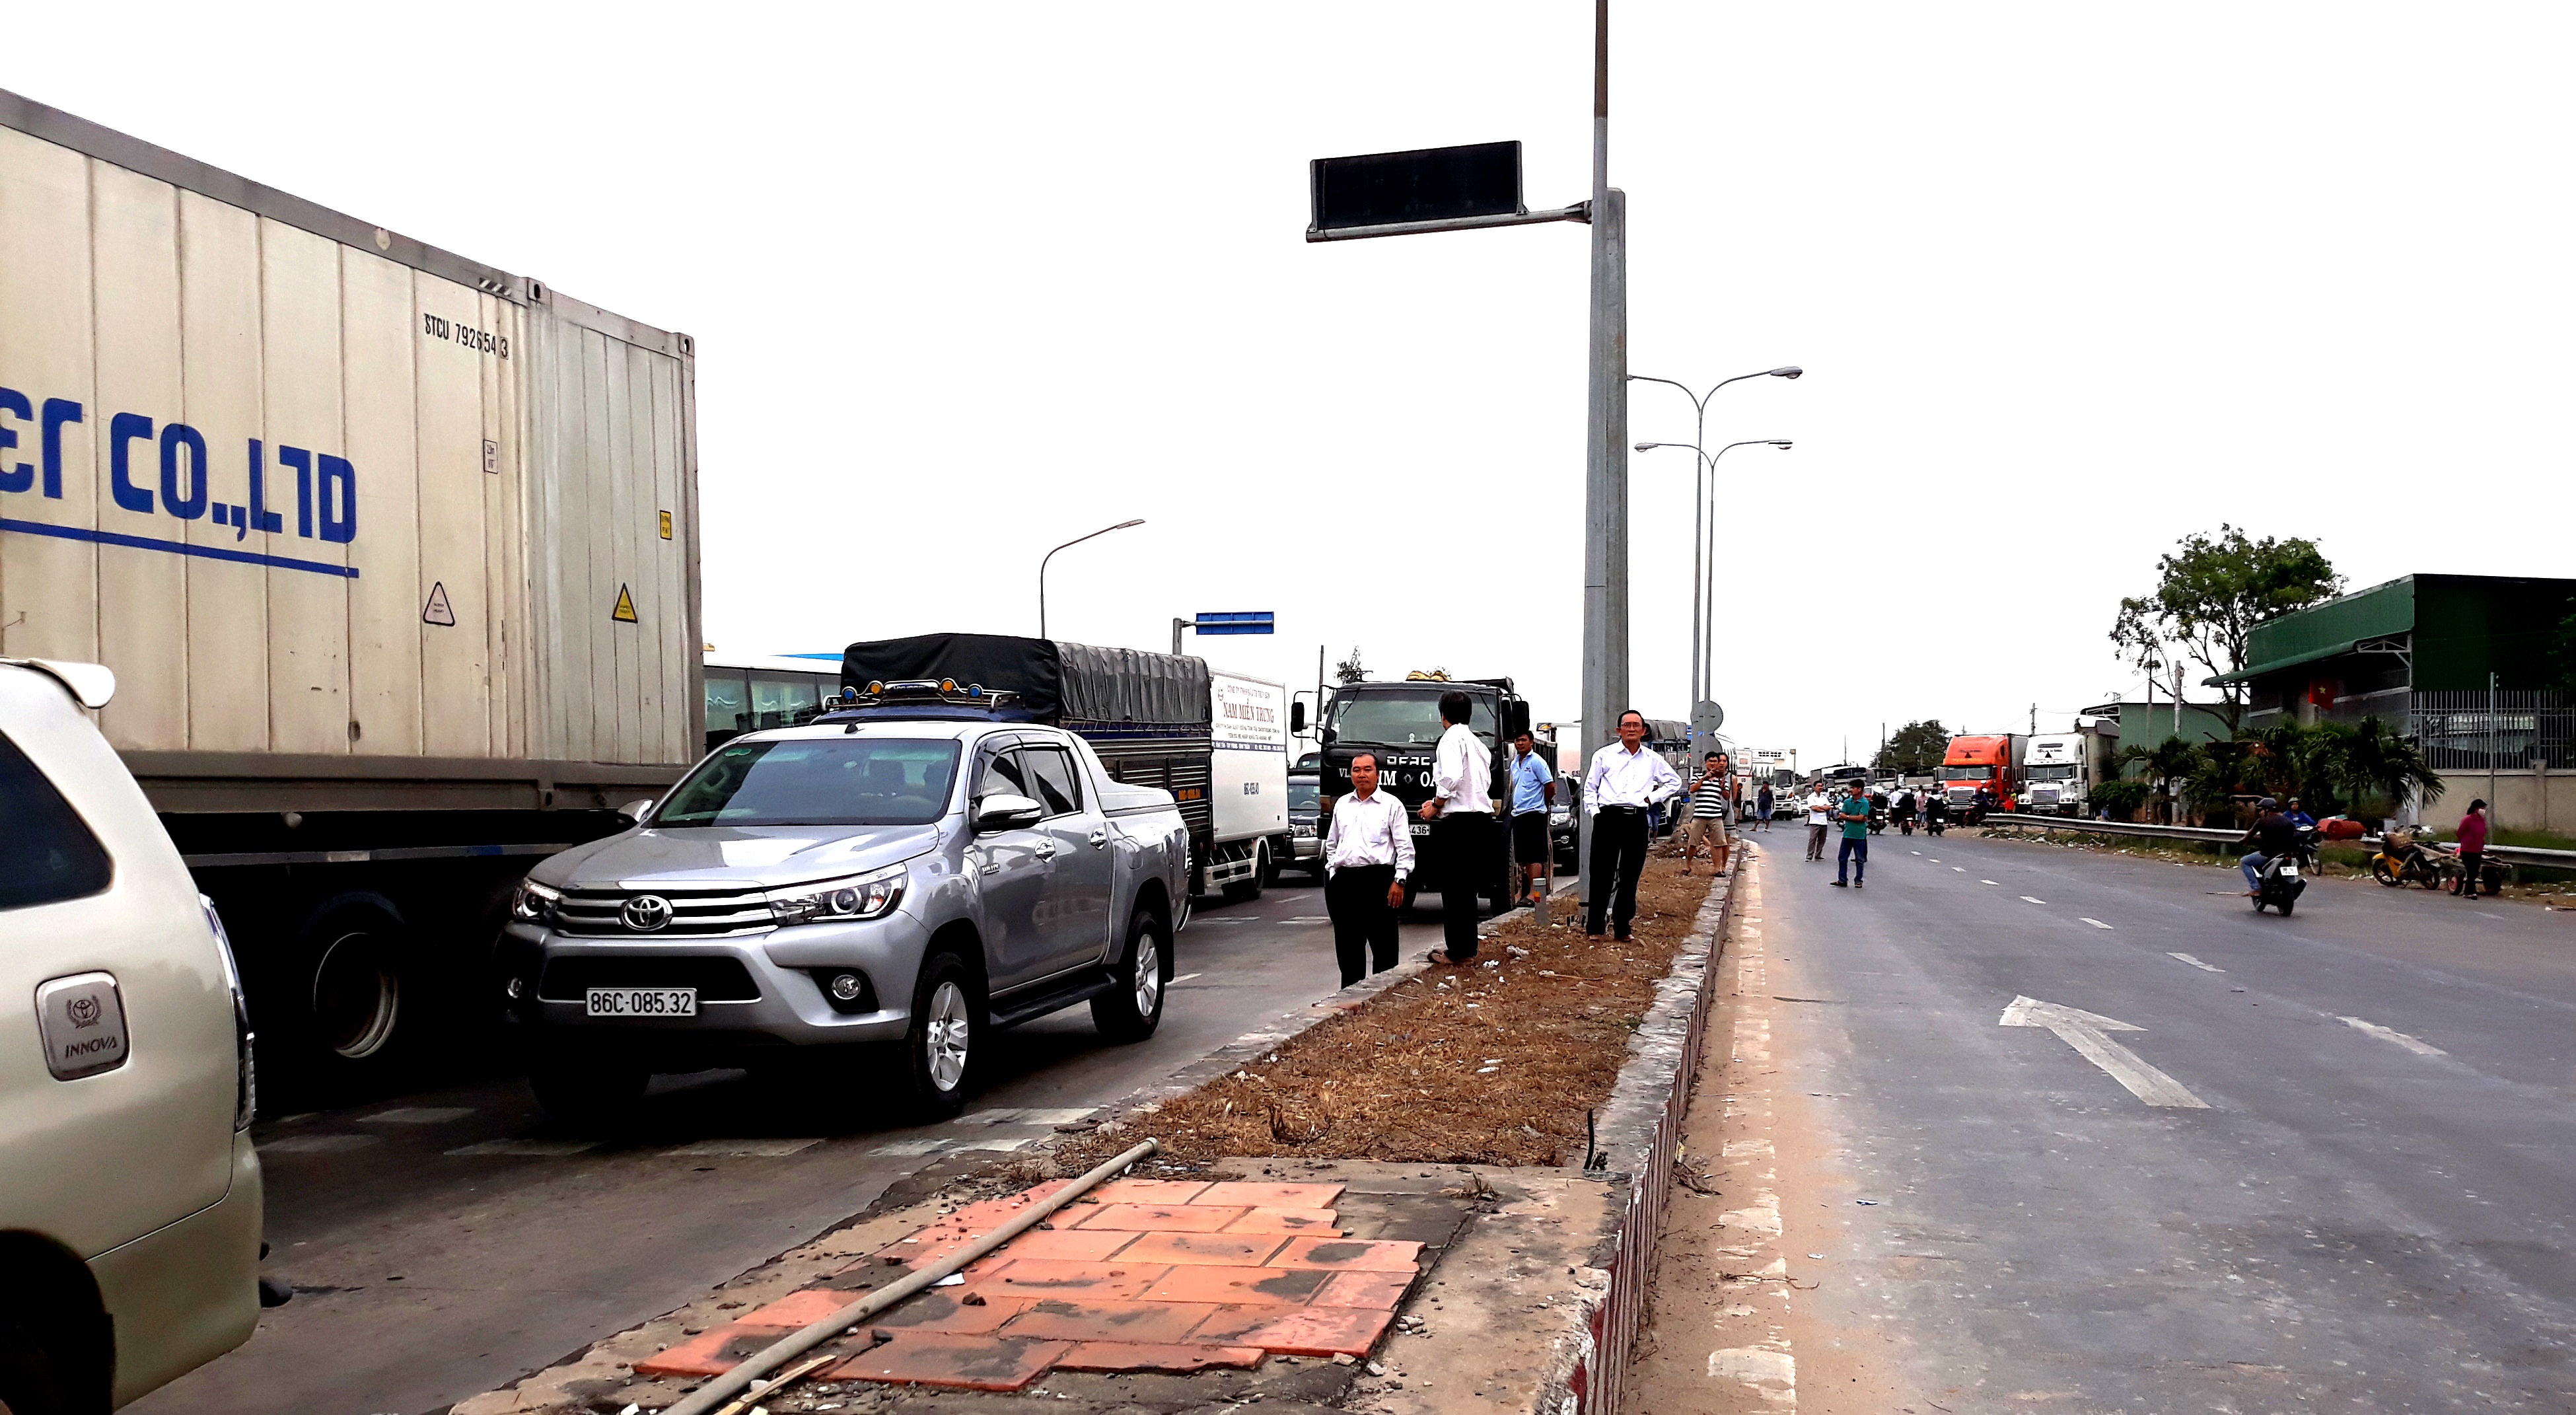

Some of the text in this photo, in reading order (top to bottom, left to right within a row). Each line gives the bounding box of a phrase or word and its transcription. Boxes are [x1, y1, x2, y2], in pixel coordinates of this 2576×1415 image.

[423, 312, 449, 340] STCU
[455, 323, 496, 355] 792654
[1223, 702, 1238, 719] NAM
[1256, 706, 1274, 723] TRUNG
[1339, 768, 1351, 778] VL
[1410, 826, 1427, 834] 436
[591, 992, 692, 1013] 86C-085.32
[65, 1035, 118, 1058] INNOVA
